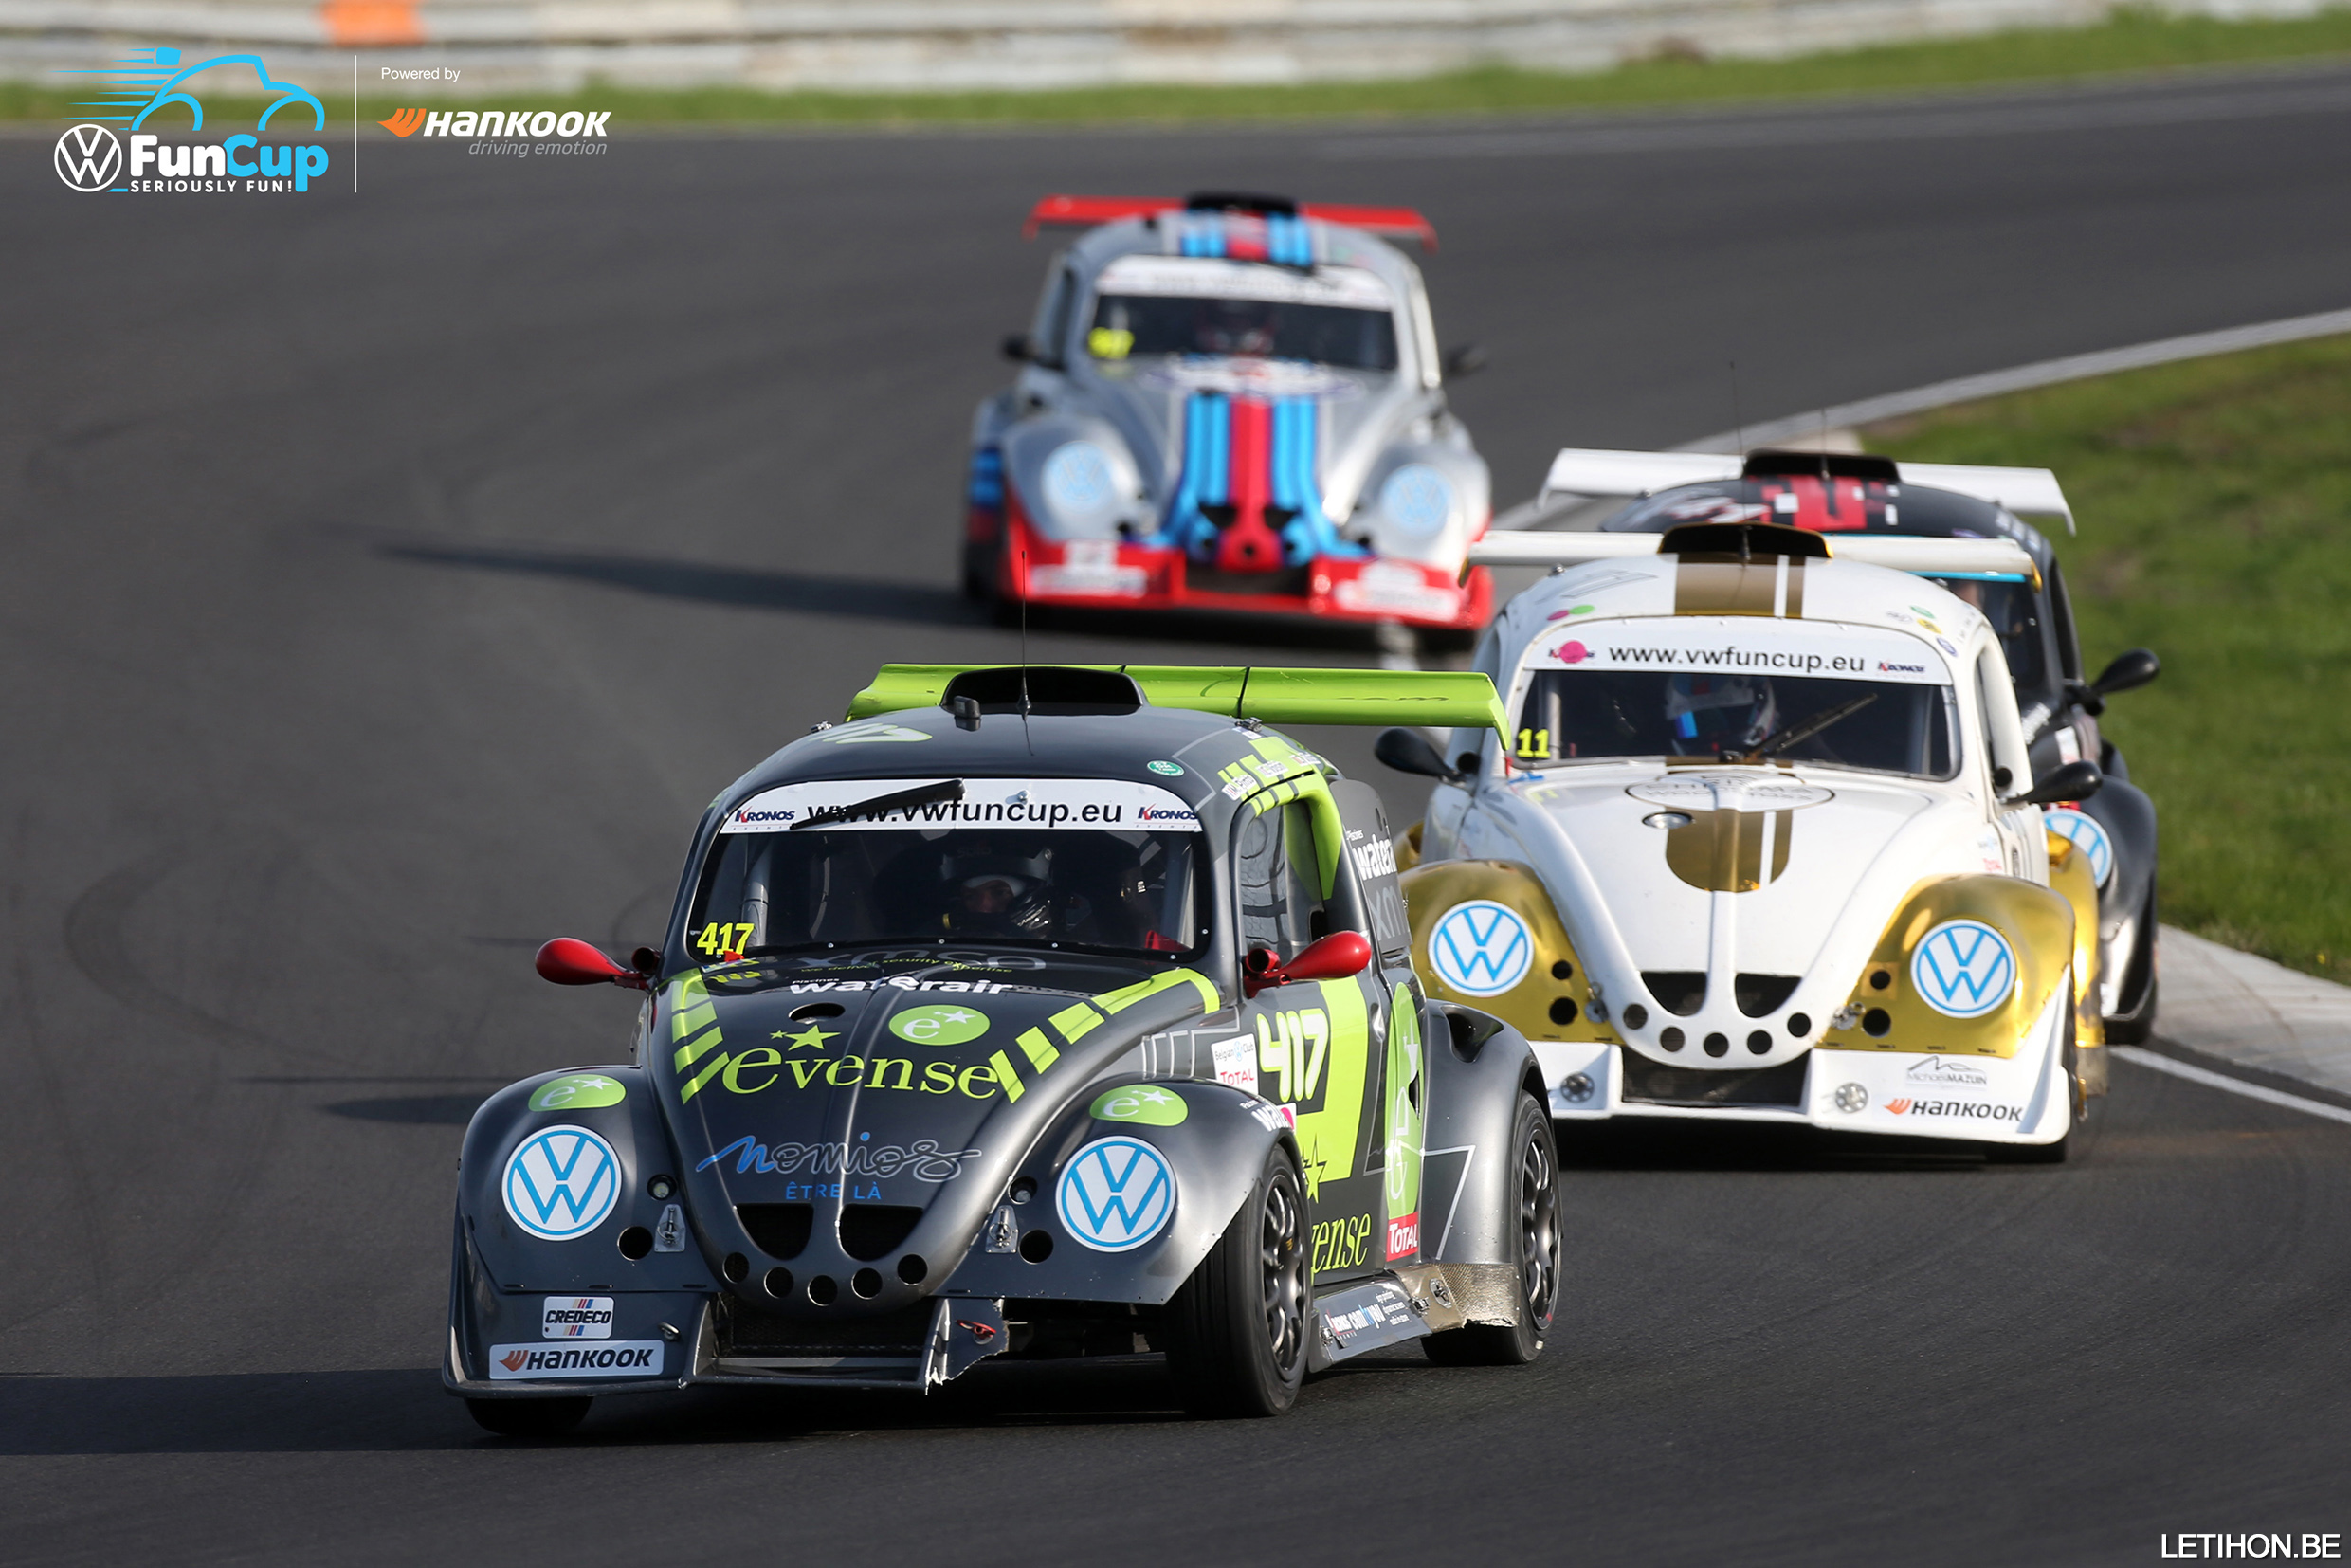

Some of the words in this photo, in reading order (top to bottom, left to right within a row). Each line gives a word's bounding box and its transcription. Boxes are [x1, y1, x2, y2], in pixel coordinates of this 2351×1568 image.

[1608, 646, 1866, 674] www.vwfuncup.eu
[1517, 728, 1551, 757] 11
[735, 806, 795, 823] KRONOS
[1138, 803, 1198, 821] KRONOS
[697, 922, 755, 956] 417
[1255, 1008, 1330, 1103] 417
[721, 1047, 1000, 1101] evense
[1220, 1068, 1255, 1085] TOTAL
[785, 1180, 842, 1200] ÊTRE
[853, 1178, 882, 1200] LÀ
[1388, 1222, 1418, 1255] TOTAL
[545, 1309, 612, 1325] CREDECO
